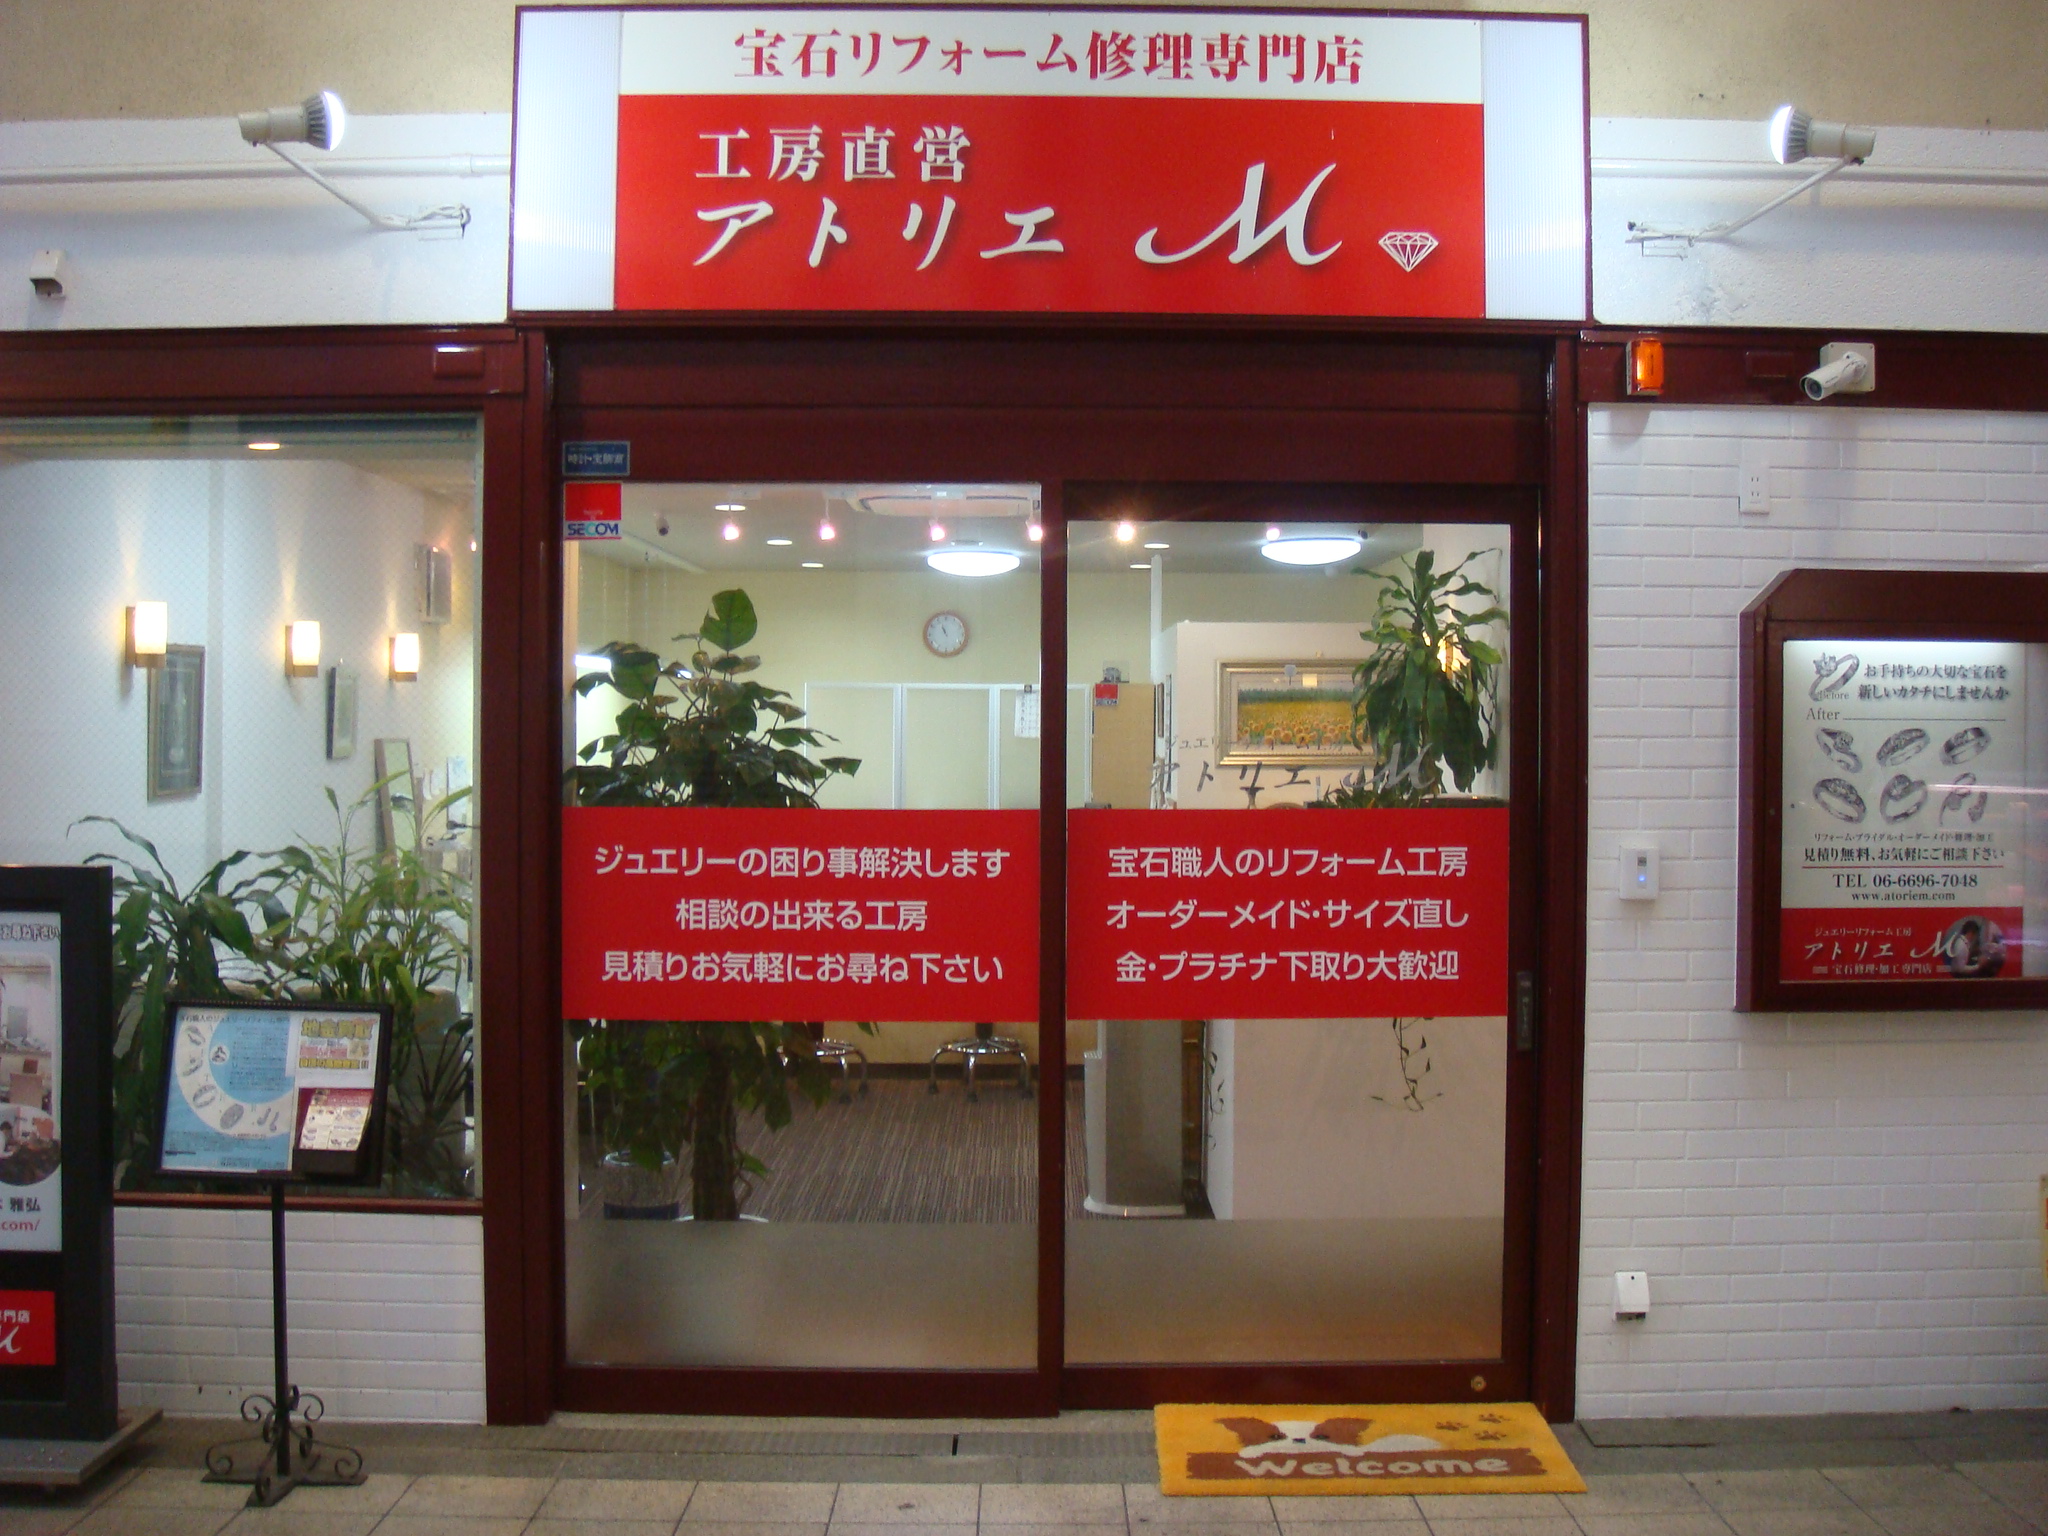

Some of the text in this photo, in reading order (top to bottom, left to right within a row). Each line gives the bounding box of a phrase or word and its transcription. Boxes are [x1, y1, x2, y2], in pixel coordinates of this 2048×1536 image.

[734, 28, 1363, 84] 宝石リフォーム修理専門店
[695, 127, 972, 182] 工房直営
[694, 162, 1342, 270] アトリエ M
[567, 522, 619, 536] SECOM
[1864, 663, 2007, 679] お手持ちの大切な宝石を
[1858, 684, 2009, 700] 新しいカタチにしませんか
[1806, 708, 1840, 720] After
[594, 845, 1010, 879] ジュエリーの困り事解決します
[1108, 847, 1468, 878] 宝石職人のリフォーム工房
[1833, 874, 1978, 888] TEL 06-6696-7048
[1851, 891, 1956, 901] www.atoriem.com
[675, 899, 928, 931] 相談の出来る工房
[1106, 899, 1469, 929] オーダーメイド・サイズ直し
[1805, 941, 1894, 960] アトリエ
[601, 951, 1004, 984] 見積りお気軽にお尋ね下さい
[1116, 951, 1459, 983] 金・プラチナ下取り大歓迎
[1234, 1457, 1510, 1477] Welcome
